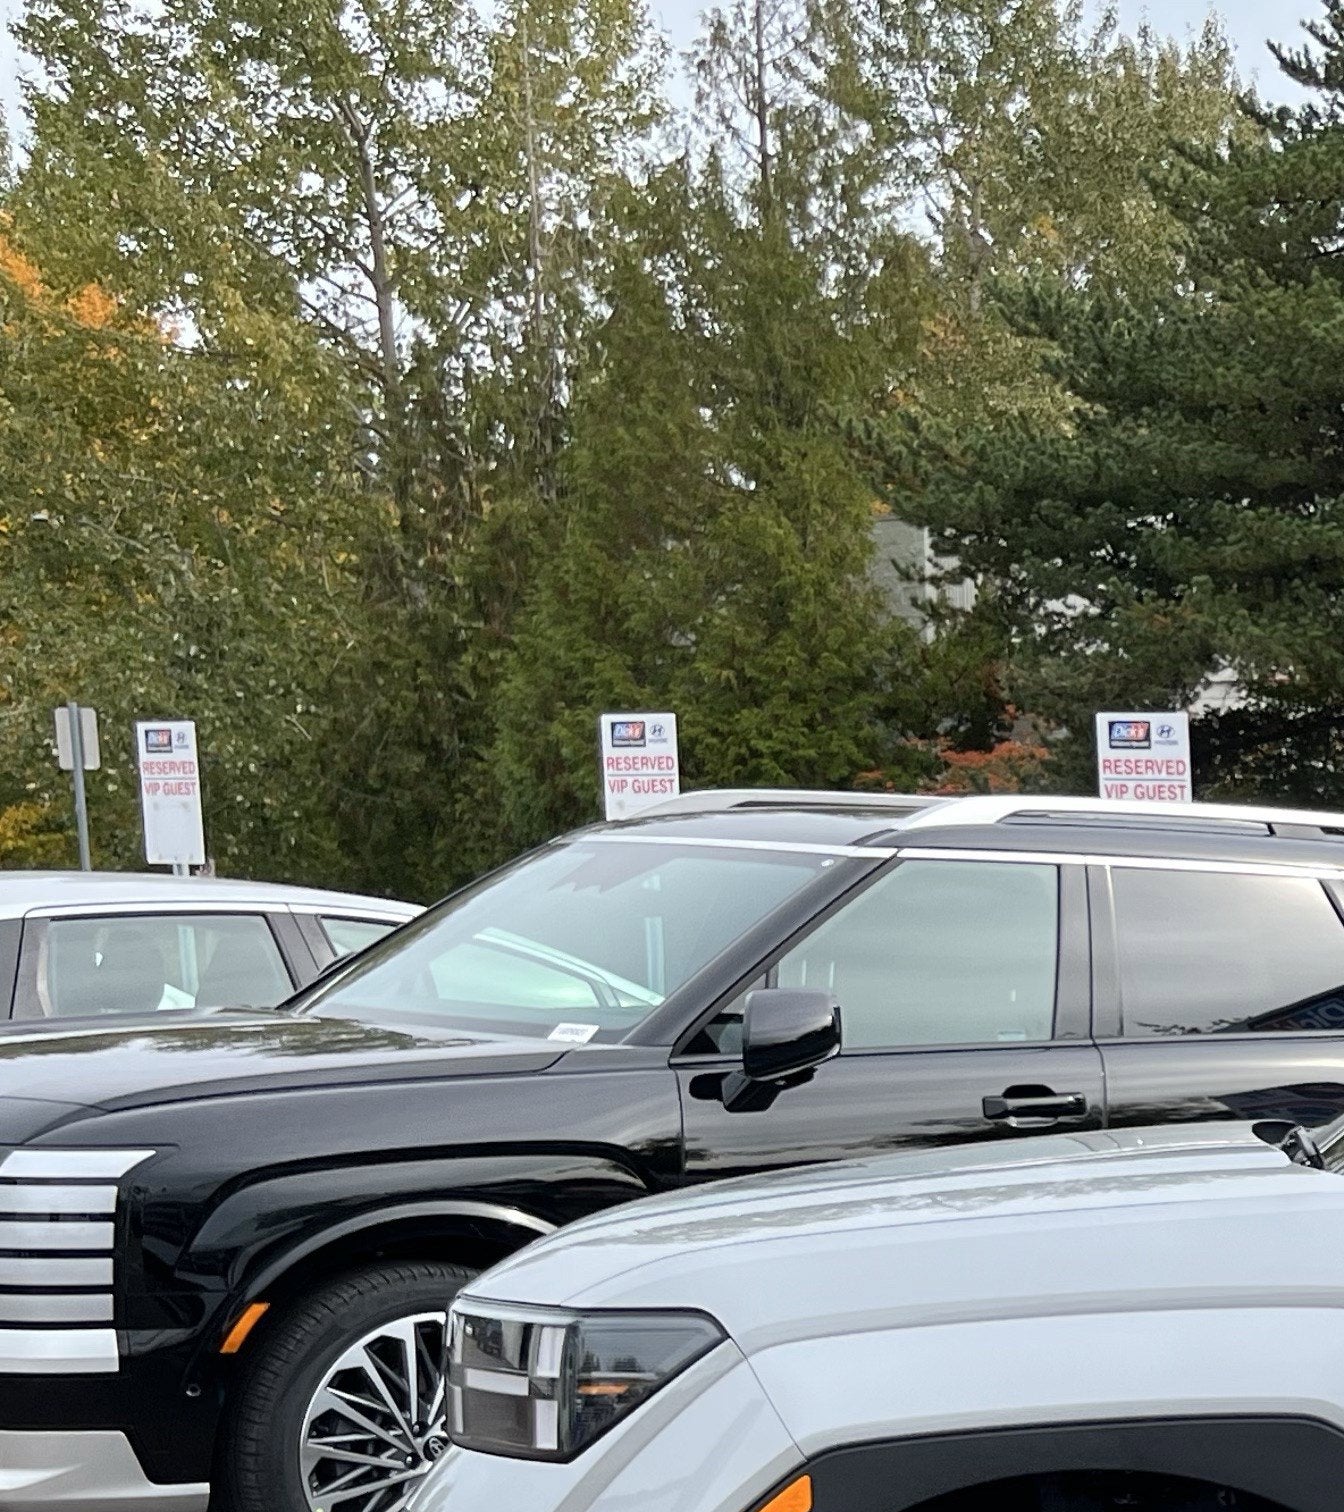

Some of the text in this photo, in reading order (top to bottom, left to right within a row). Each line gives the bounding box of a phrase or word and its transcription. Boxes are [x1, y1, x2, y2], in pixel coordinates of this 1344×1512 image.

[142, 761, 196, 775] RESERVED
[606, 755, 675, 771] RESERVED
[1102, 758, 1186, 776] RESERVED
[144, 781, 196, 795] VIP GUEST
[608, 778, 675, 794] VIP GUEST
[1104, 783, 1186, 800] VIP GUEST
